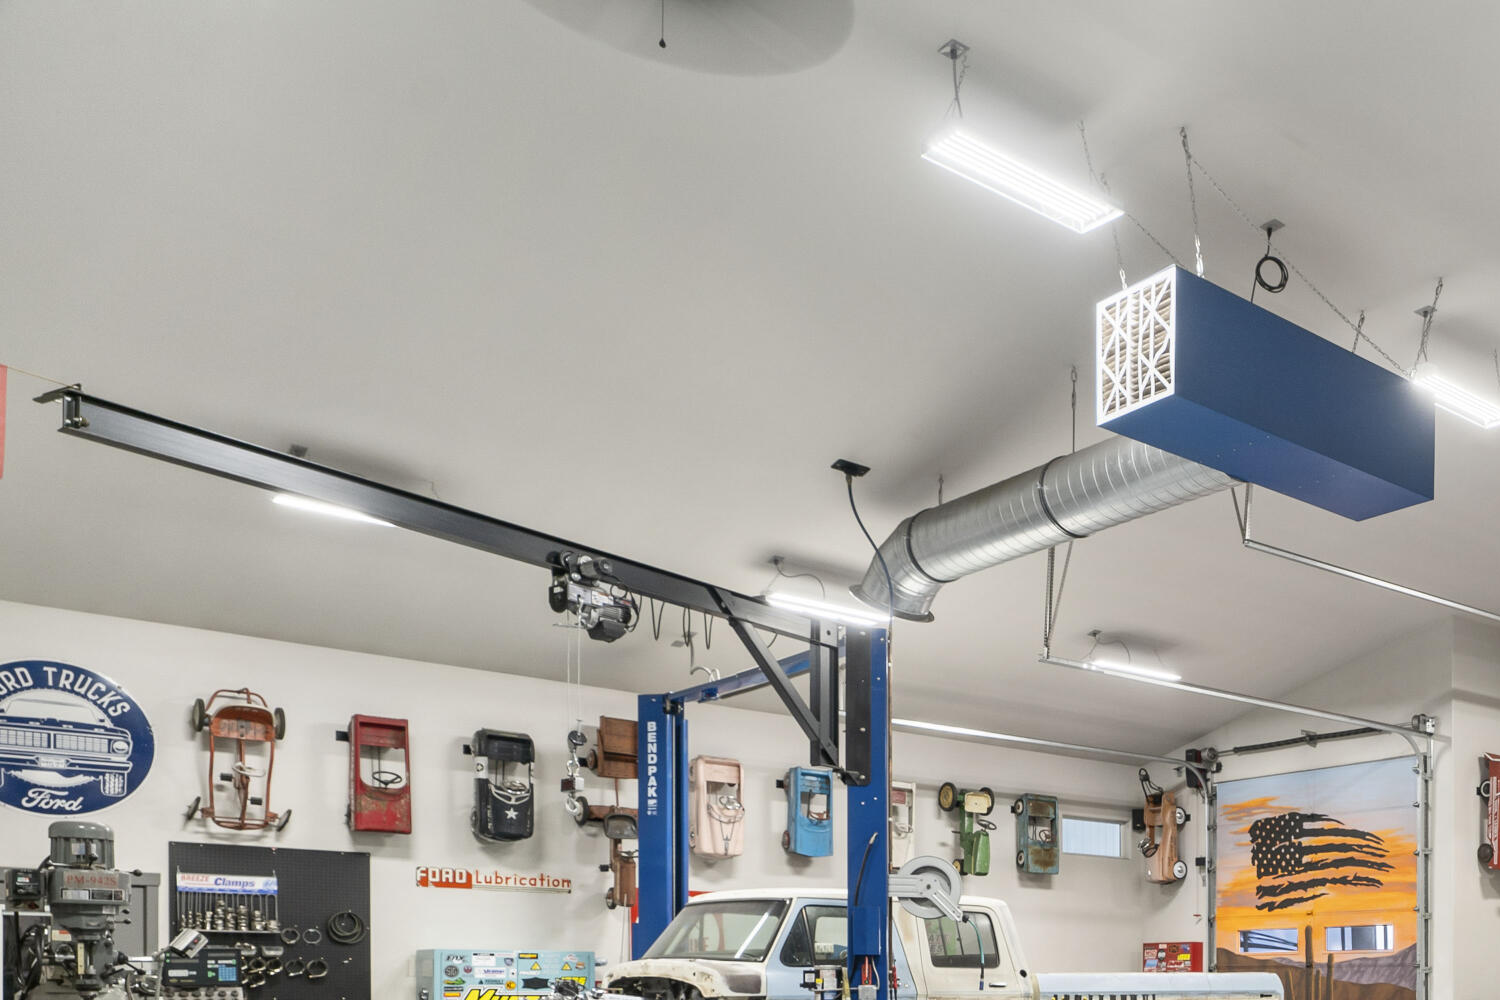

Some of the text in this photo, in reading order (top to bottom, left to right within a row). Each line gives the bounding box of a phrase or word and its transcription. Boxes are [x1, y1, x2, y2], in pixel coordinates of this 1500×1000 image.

[43, 666, 131, 717] TRUCKS
[647, 721, 658, 797] BENDPAK
[21, 788, 84, 811] Ford
[181, 874, 256, 888] BREEZE Clamps
[417, 867, 571, 888] FORD Lubrication
